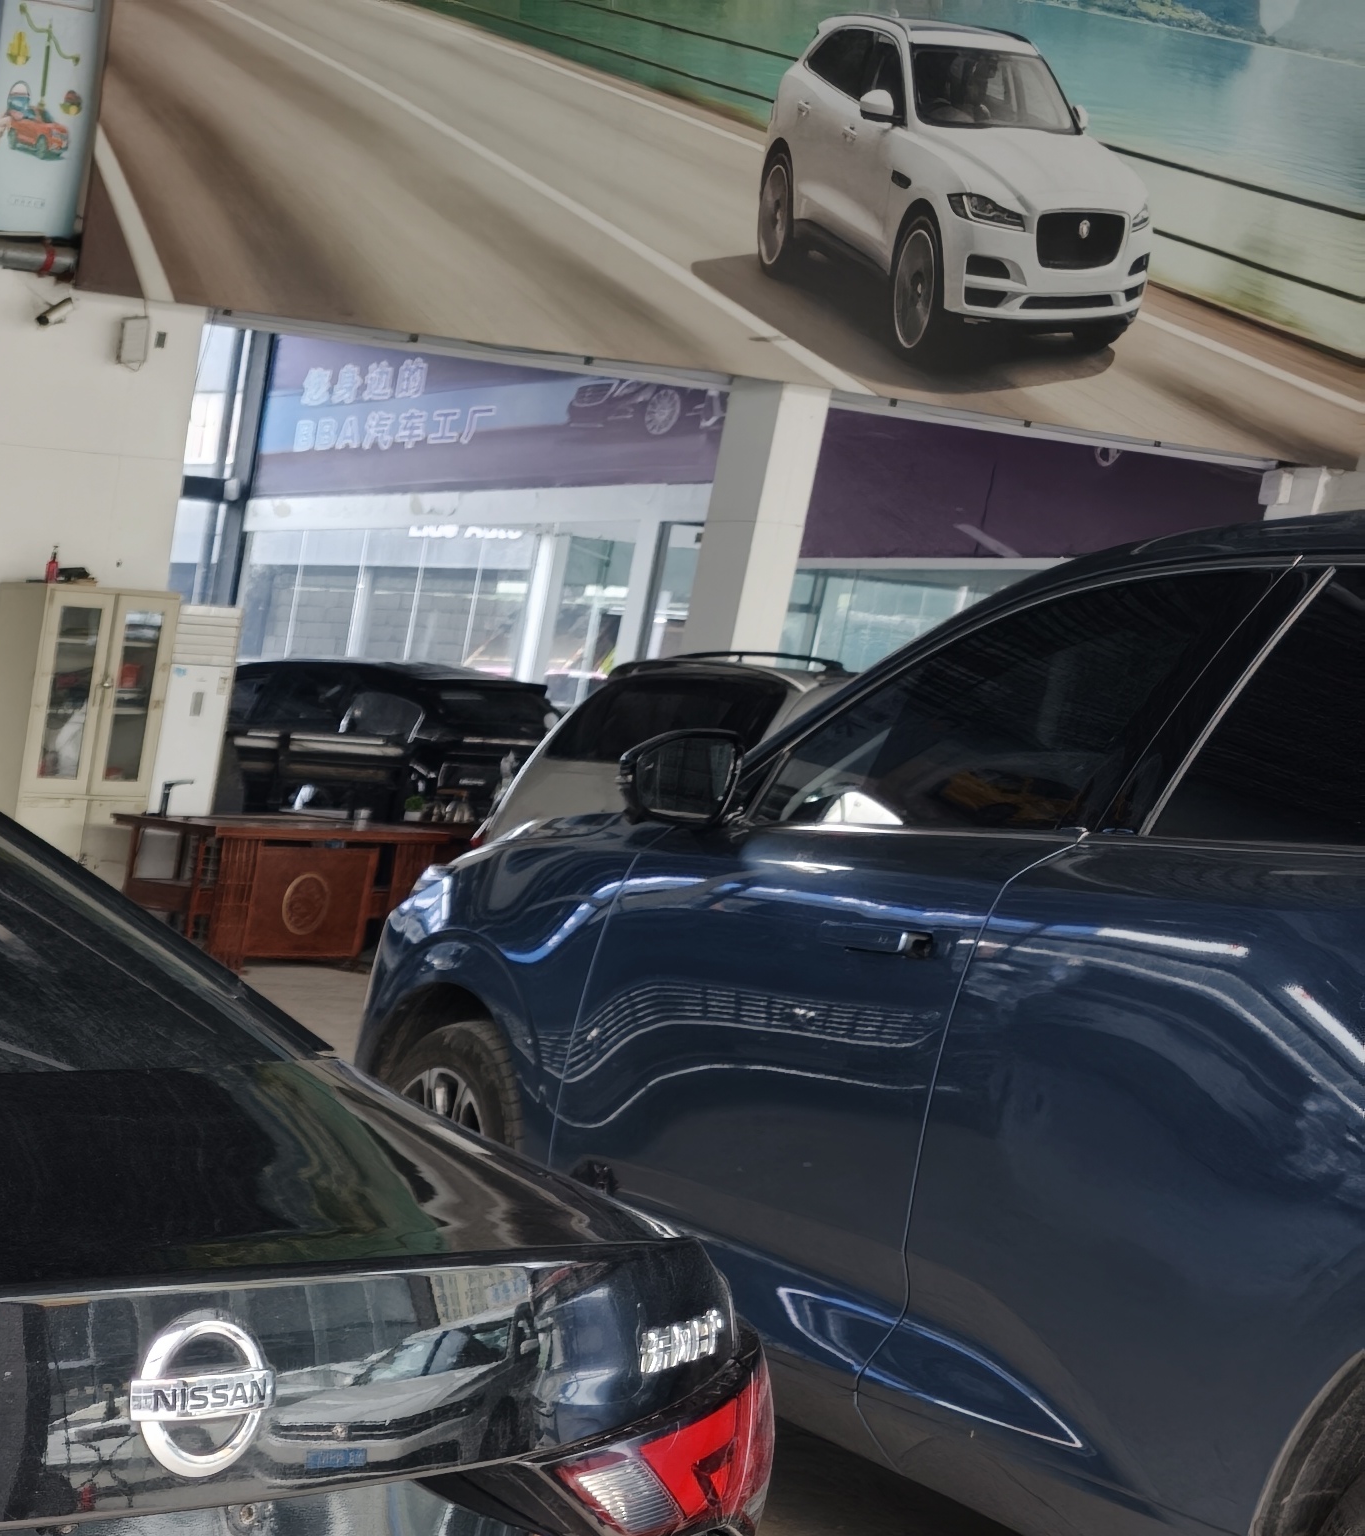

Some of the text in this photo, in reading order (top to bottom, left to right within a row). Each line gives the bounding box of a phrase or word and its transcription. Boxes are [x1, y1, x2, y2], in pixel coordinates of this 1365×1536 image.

[293, 405, 497, 452] BBA汽车工厂
[152, 1378, 267, 1412] NISSAN
